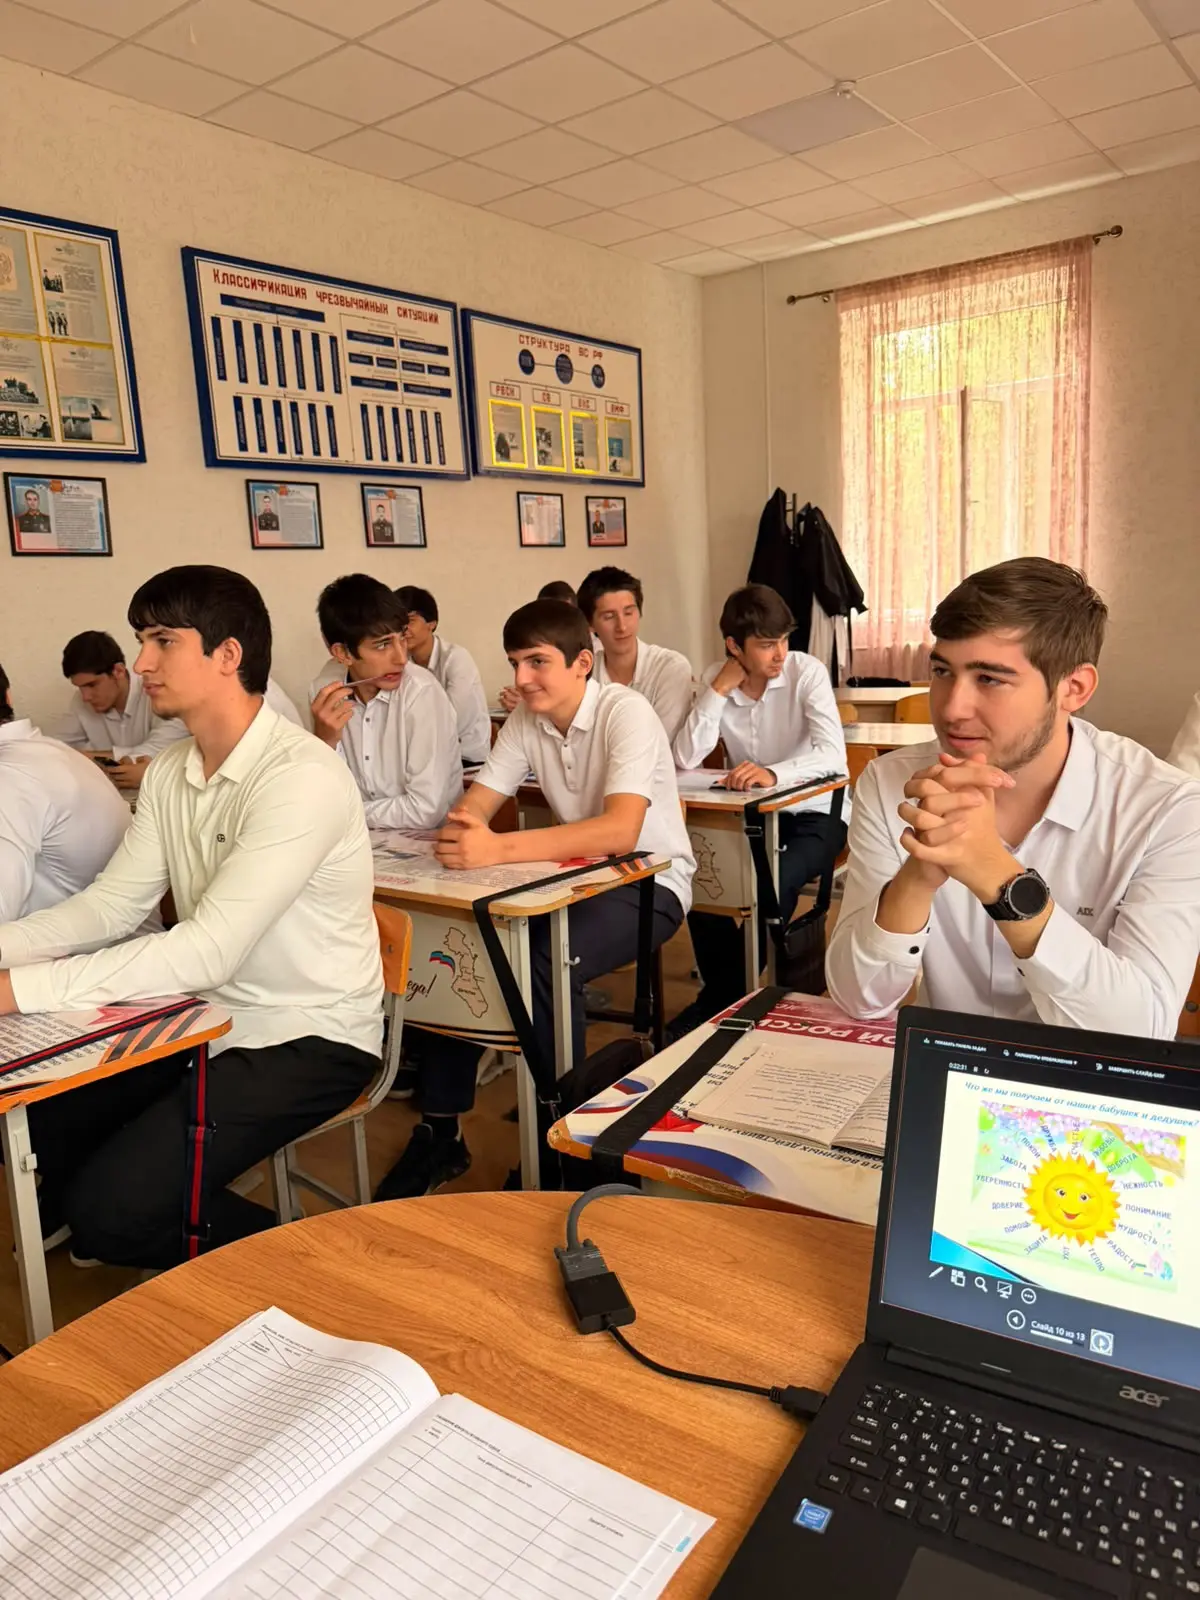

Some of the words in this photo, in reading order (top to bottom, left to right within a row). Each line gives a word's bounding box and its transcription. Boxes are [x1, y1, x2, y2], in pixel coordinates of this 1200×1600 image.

[213, 268, 307, 300] КЛАССИФИКАЦИЯ
[316, 290, 389, 315] ЧРЕЗВЫЧАЙНЫХ
[397, 306, 439, 324] СИТУАЦИЙ
[518, 334, 570, 353] СТРУКТУРА
[579, 347, 589, 357] ВС
[593, 350, 603, 360] РФ
[965, 1081, 980, 1091] Что
[994, 1088, 1008, 1096] мы
[1009, 1090, 1052, 1104] получаем
[1066, 1101, 1097, 1110] наших
[1098, 1104, 1139, 1118] бабушек
[1150, 1113, 1200, 1127] дедушек?
[735, 1130, 802, 1149] ДЕЙСТВИЯХ
[1020, 1137, 1041, 1158] ПОКОЙ
[1040, 1125, 1057, 1152] ДРУЖБА
[802, 1146, 859, 1164] ВОЕННЫХ
[1001, 1154, 1027, 1172] ЗАБОТА
[1106, 1153, 1138, 1173] ДОБРОТА
[976, 1174, 1025, 1189] УВЕРЕННОСТЬ
[1122, 1181, 1163, 1190] НЕЖНОСТЬ
[992, 1202, 1024, 1210] ДОВЕРИЕ
[1125, 1203, 1172, 1219] ПОНИМАНИЕ
[1118, 1222, 1158, 1245] МУДРОСТЬ
[1024, 1234, 1048, 1255] ЗАЩИТА
[1107, 1239, 1137, 1269] РАДОСТЬ
[1088, 1247, 1105, 1272] ТЕПЛО
[1031, 1320, 1054, 1334] Слайд
[1055, 1326, 1065, 1335] 10
[1065, 1330, 1075, 1338] из
[1076, 1332, 1086, 1341] 13
[1119, 1385, 1170, 1408] acer
[922, 1432, 931, 1440] W
